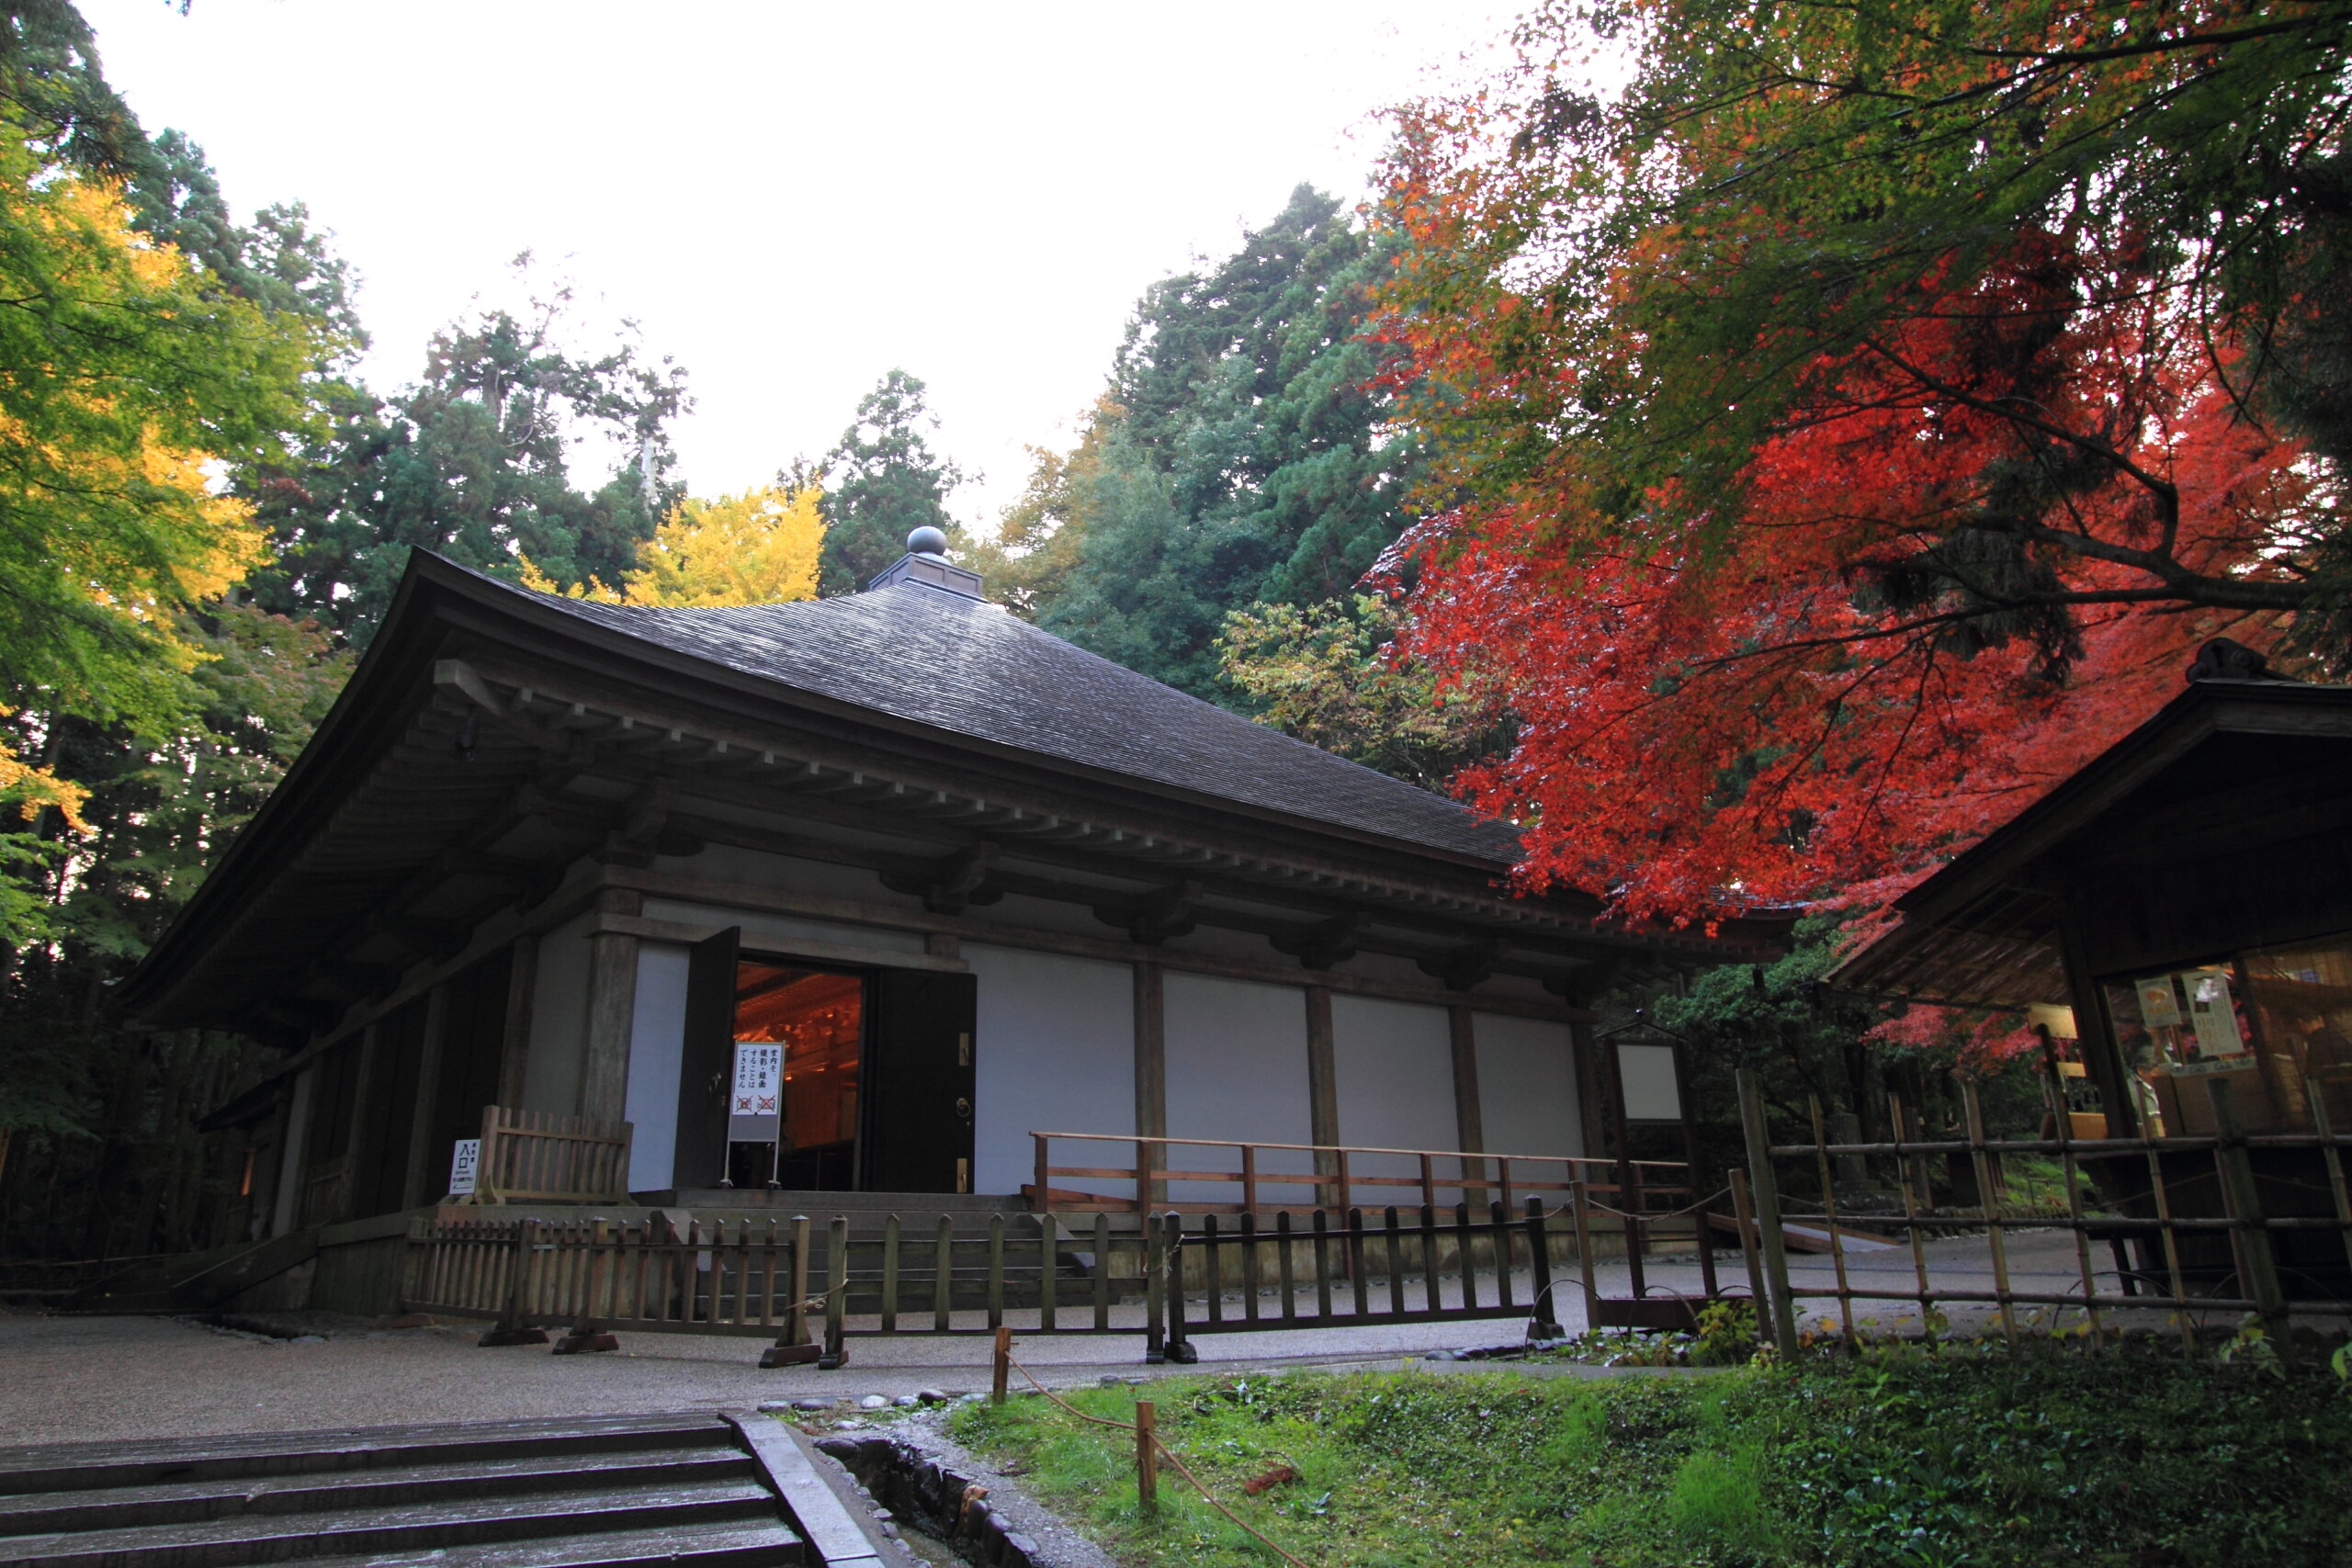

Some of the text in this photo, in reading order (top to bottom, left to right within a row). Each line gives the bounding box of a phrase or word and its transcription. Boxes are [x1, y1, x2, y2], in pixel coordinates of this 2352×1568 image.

[738, 1049, 748, 1088] できません
[748, 1049, 757, 1088] することは
[458, 1144, 470, 1168] 入口
